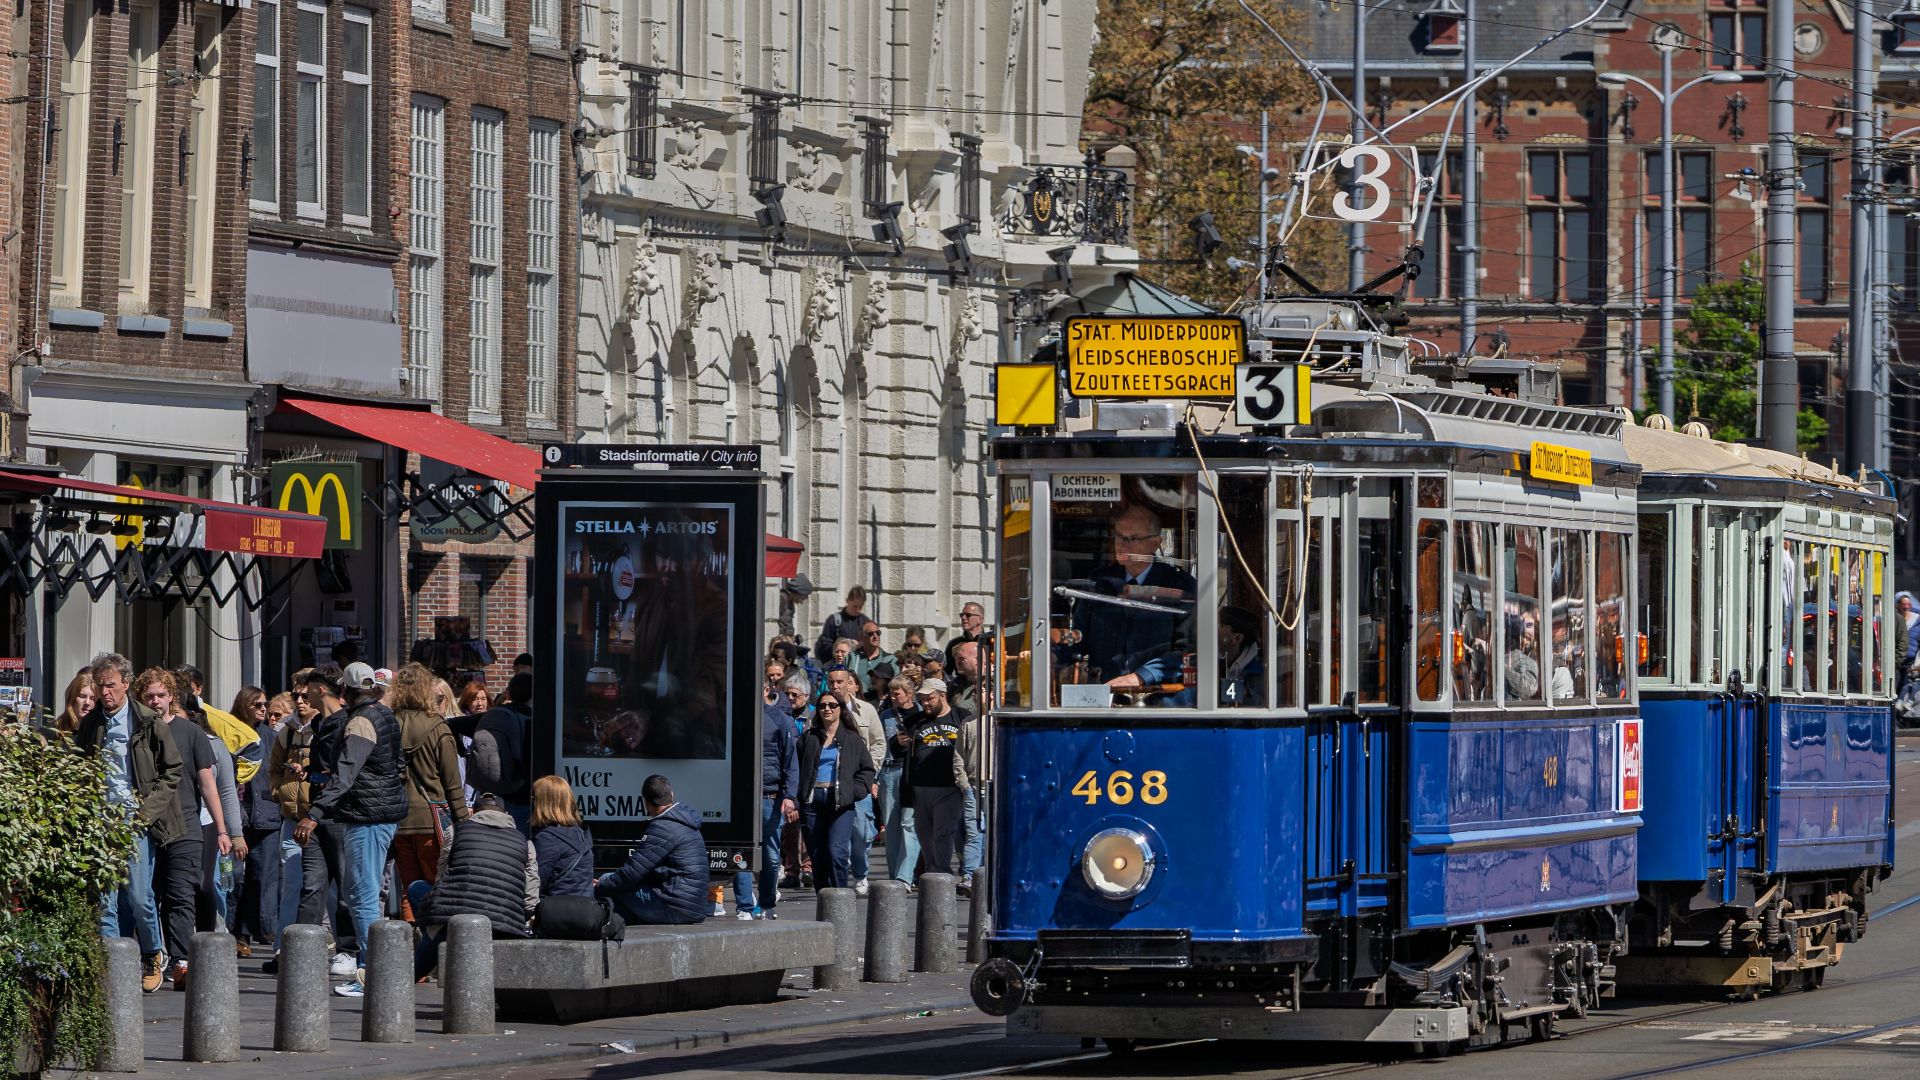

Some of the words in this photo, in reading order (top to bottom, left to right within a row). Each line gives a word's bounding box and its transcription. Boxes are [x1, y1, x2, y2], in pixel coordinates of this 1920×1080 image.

[1333, 145, 1391, 221] 3
[1072, 322, 1116, 341] STAT.
[1121, 322, 1241, 341] MUIDERPOORT
[1076, 347, 1237, 365] LEIDSCHEBOSCHJE
[1075, 372, 1235, 391] ZOUTKEETSGRACH
[1243, 366, 1285, 421] 3
[599, 449, 700, 462] Stadsinformatie
[710, 449, 734, 464] City
[735, 449, 758, 462] info
[1062, 475, 1111, 486] OCHTEND-
[1010, 485, 1029, 503] VOL
[1053, 487, 1120, 498] ABONNEMENT
[420, 527, 444, 536] 100%
[445, 527, 488, 536] HOLLND
[575, 520, 636, 533] STELLA
[654, 521, 717, 534] ARTOIS
[1226, 682, 1236, 700] 4
[563, 765, 613, 788] Meer
[1071, 769, 1168, 805] 468
[577, 795, 599, 816] AN
[710, 849, 728, 859] info
[710, 860, 728, 869] info
